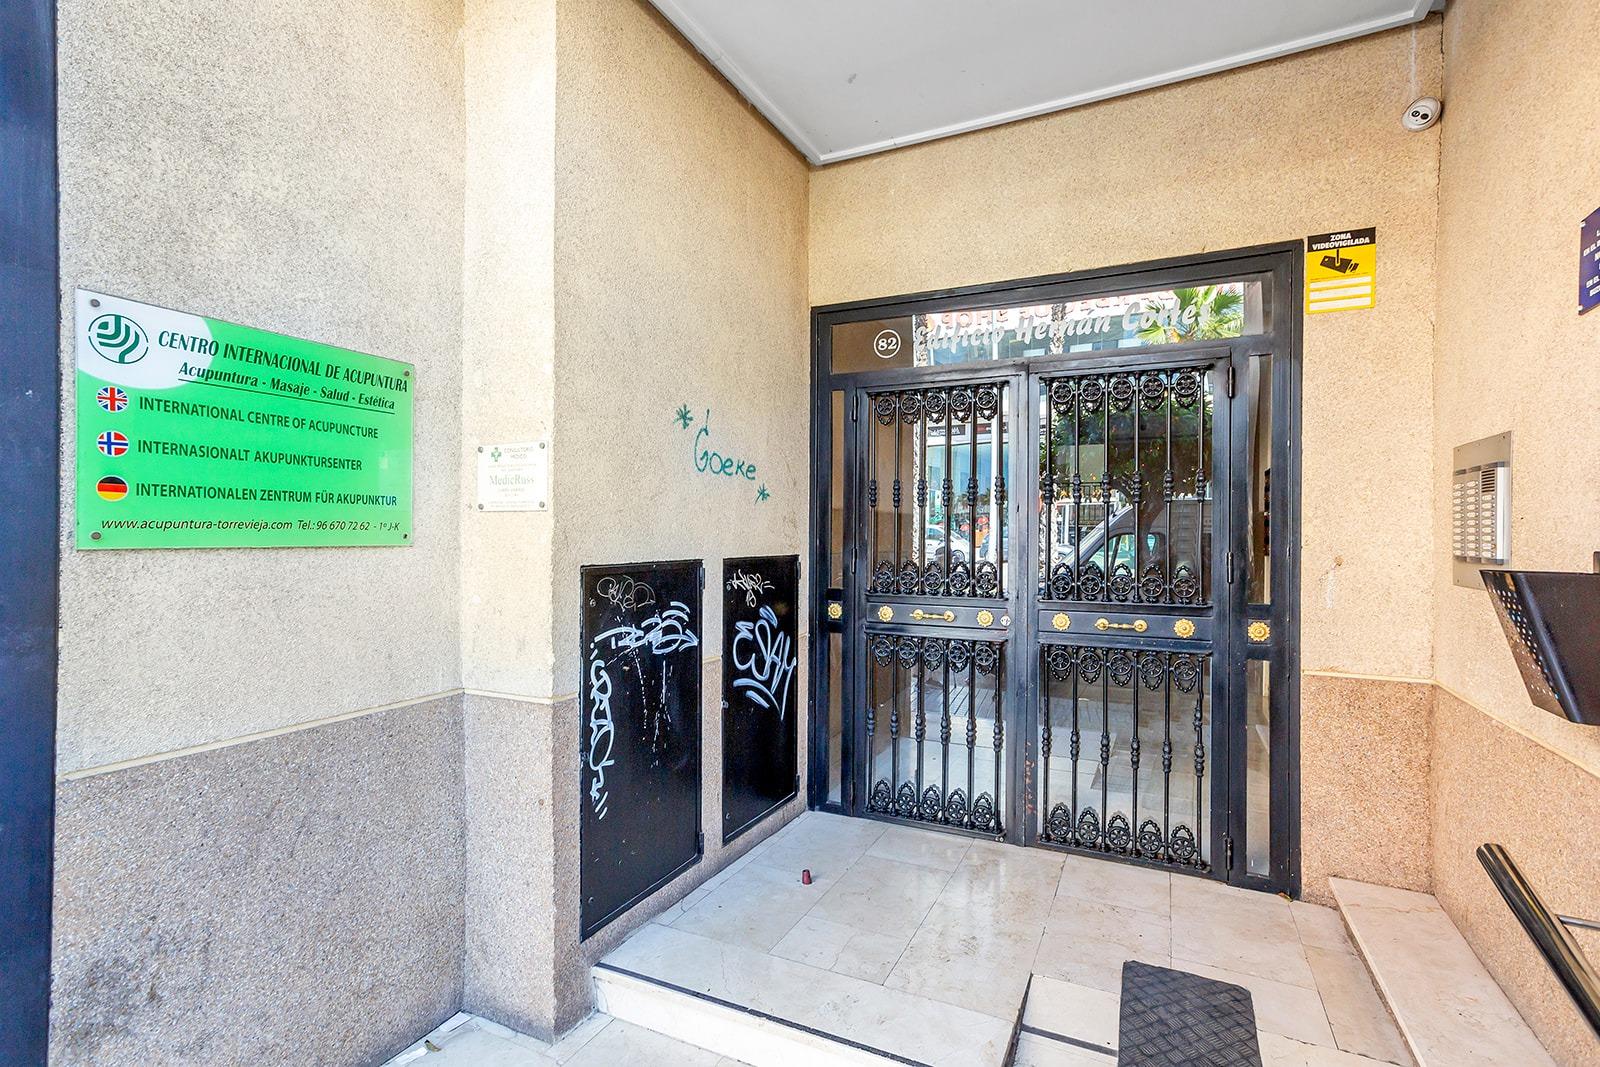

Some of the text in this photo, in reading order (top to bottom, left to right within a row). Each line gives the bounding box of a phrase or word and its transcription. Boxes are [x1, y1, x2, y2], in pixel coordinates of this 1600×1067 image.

[1312, 237, 1370, 250] VIDEOVIGILADA
[1330, 233, 1352, 242] ZONA
[876, 337, 899, 350] 82
[914, 326, 1006, 352] Edificio
[158, 330, 408, 393] CENTRO INTERNACIONAL DE ACUPUNTURA
[178, 361, 259, 388] Acupuntura
[270, 377, 310, 396] Masaje
[320, 385, 350, 403] Salud
[358, 392, 395, 410] Estética
[139, 396, 379, 439] INTERNATIONAL CENTRE OF ACUPUNCTURE
[137, 440, 362, 471] INTERNASIONALT AKUPUNKTURSENTER
[135, 482, 397, 507] INTERNATIONALEN ZENTRUM FÜR AKUPUNKTUR
[101, 517, 293, 532] www.acupuntura-torrevieja.com
[329, 521, 346, 531] 670
